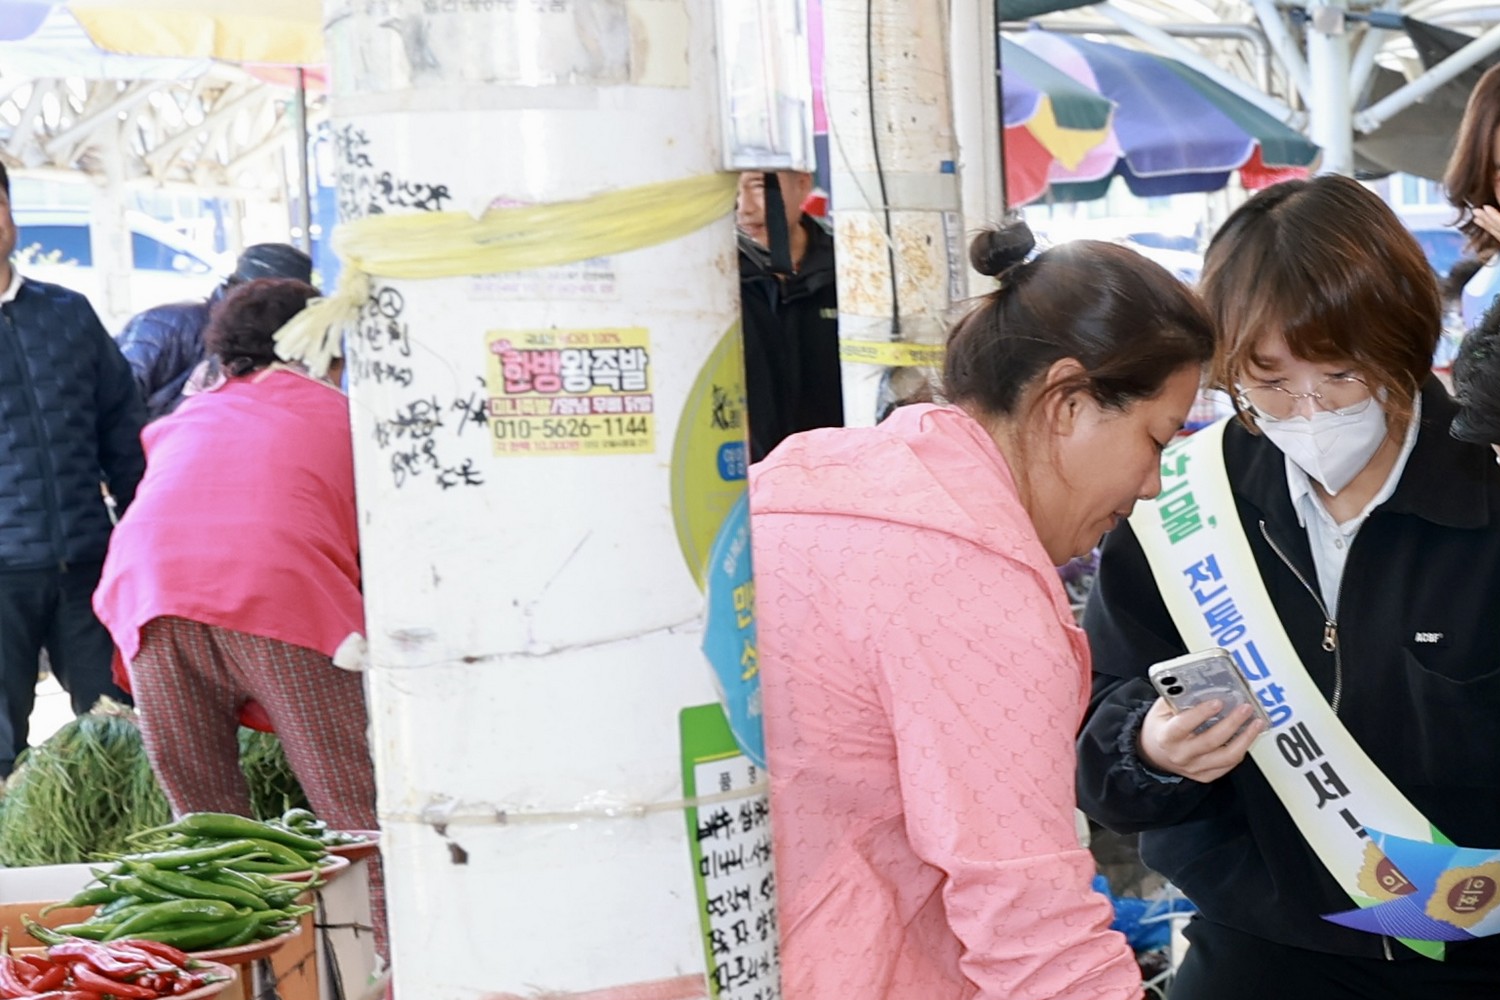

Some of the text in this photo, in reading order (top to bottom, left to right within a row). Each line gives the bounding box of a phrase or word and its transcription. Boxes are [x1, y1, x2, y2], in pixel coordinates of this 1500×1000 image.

[500, 346, 649, 394] 한방왕족발
[494, 416, 648, 439] 010-5626-1144
[1454, 878, 1485, 911] 의회
